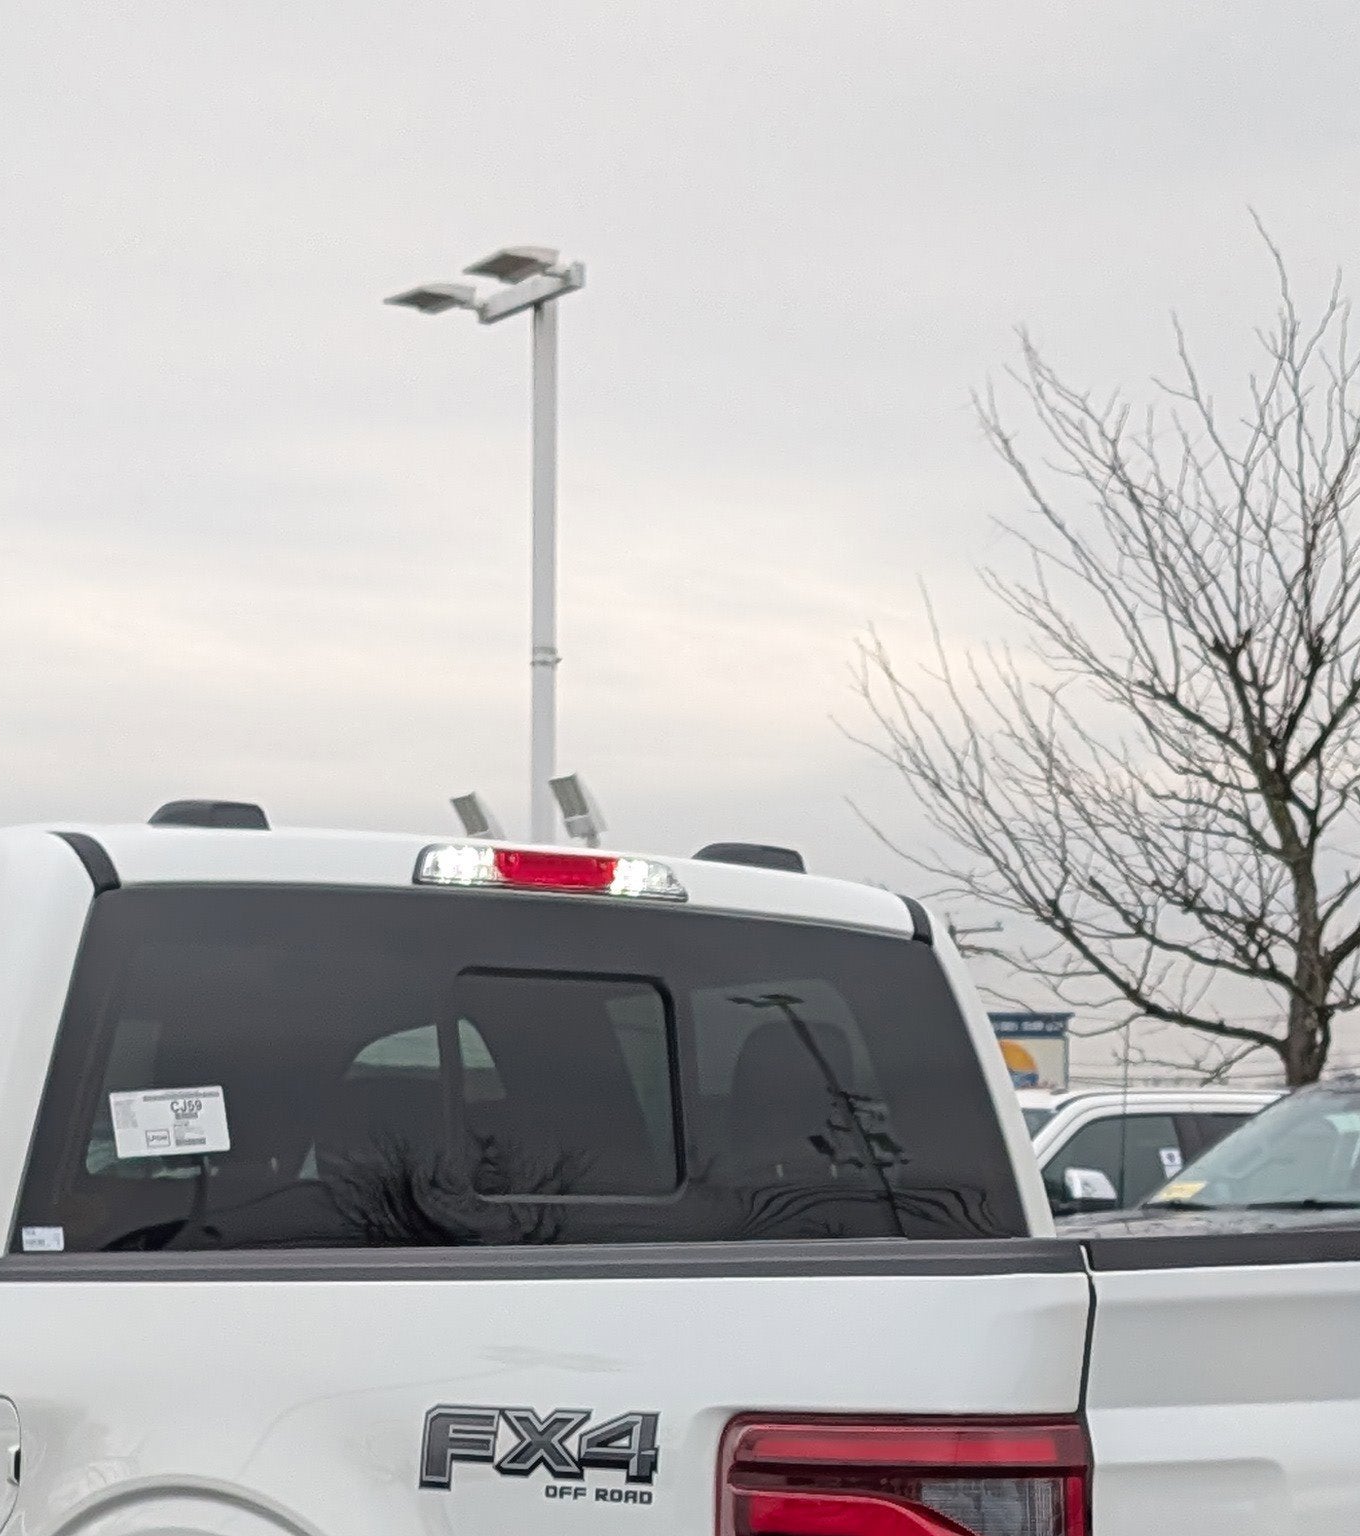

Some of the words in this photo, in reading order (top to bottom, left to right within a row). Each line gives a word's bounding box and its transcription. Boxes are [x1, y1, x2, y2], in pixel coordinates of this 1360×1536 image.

[419, 1403, 661, 1491] FX4
[545, 1485, 587, 1500] OFF
[595, 1488, 654, 1504] ROAD
